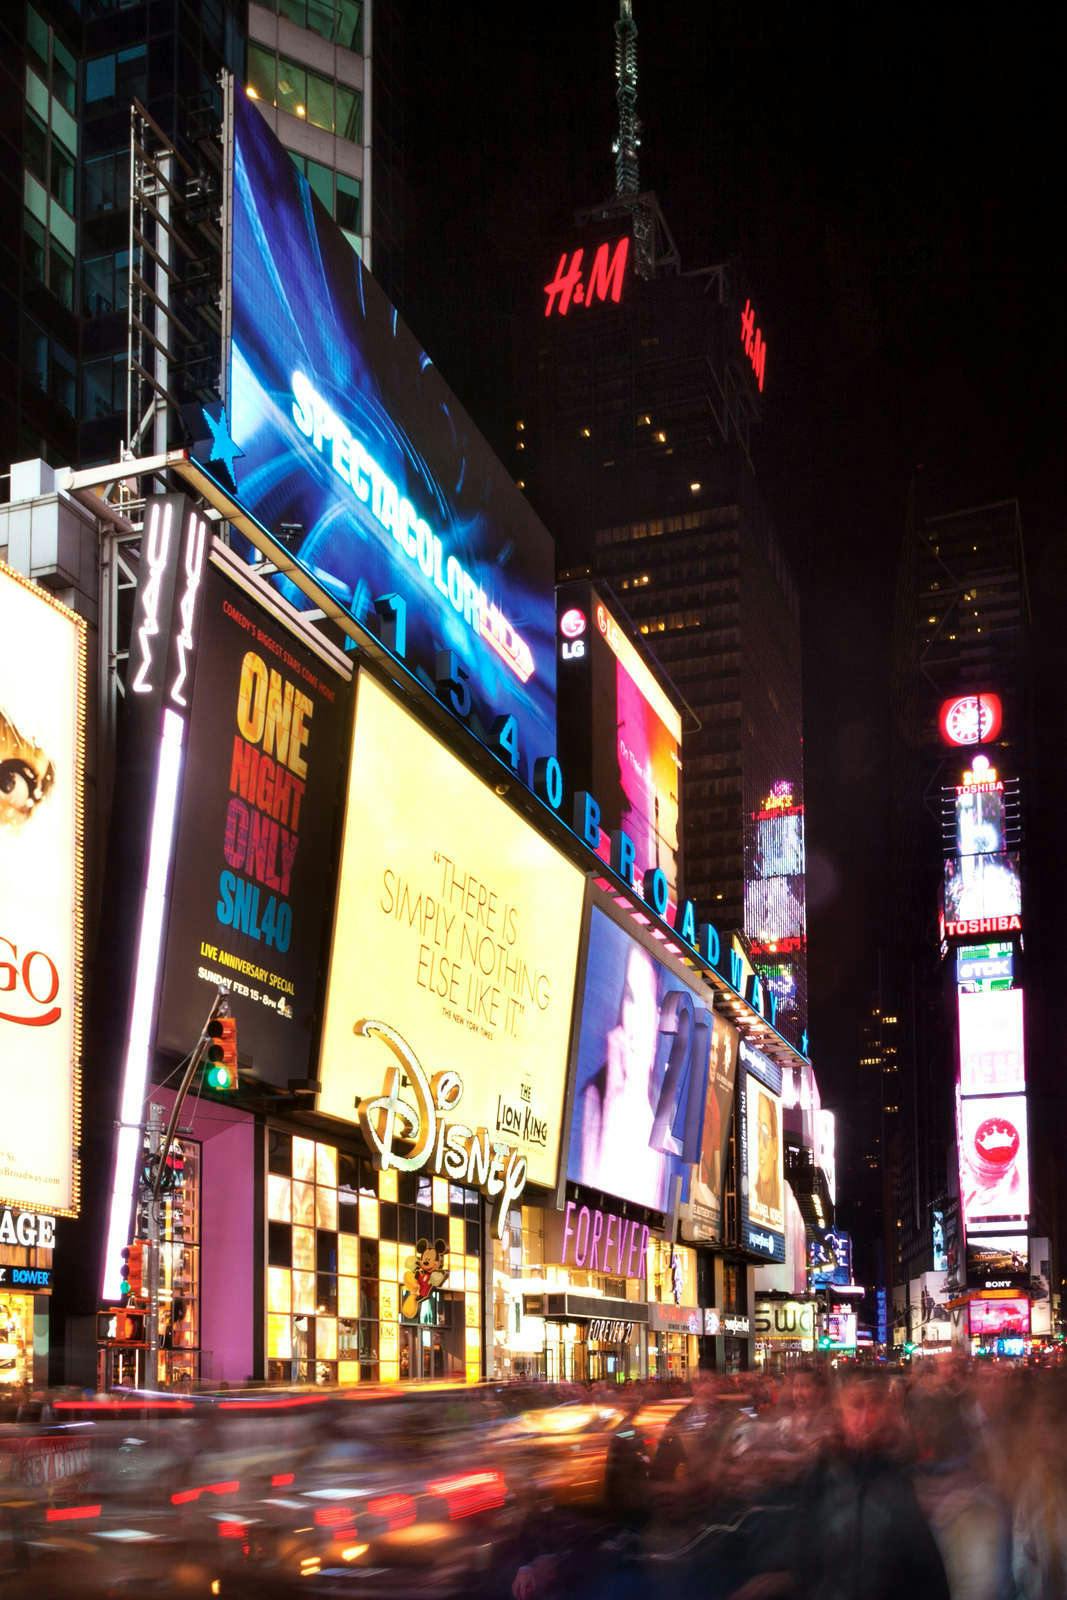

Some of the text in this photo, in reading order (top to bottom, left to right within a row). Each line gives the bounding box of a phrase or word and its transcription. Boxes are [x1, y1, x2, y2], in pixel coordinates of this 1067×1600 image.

[544, 237, 629, 317] H&M
[741, 299, 766, 392] H&M
[562, 640, 584, 659] LG
[237, 651, 313, 780] ONE
[229, 735, 306, 833] NIGHT
[956, 781, 1004, 795] TOSHIBA
[223, 795, 299, 896] ONLY
[216, 869, 293, 953] SNL40
[432, 850, 519, 946] "THERE IS
[583, 789, 778, 1027] BROADWAY
[945, 915, 1021, 936] TOSHIBA
[200, 942, 295, 995] LIVE ANNIVERSARY SPECIAL
[380, 869, 551, 1011] SIMPLY NOTHING
[198, 967, 233, 989] SUNDAY
[232, 981, 249, 997] FEB
[249, 989, 260, 1001] 15
[416, 944, 462, 1006] ELSE
[466, 976, 500, 1027] LIKE
[520, 1083, 531, 1099] THE
[648, 990, 713, 1165] 21
[496, 1094, 547, 1142] LION KING
[0, 1209, 56, 1248] AGE
[561, 1201, 649, 1280] FOREVER
[12, 1268, 49, 1287] BOWER
[985, 1280, 1012, 1288] SONY
[588, 1319, 625, 1343] FOREVER
